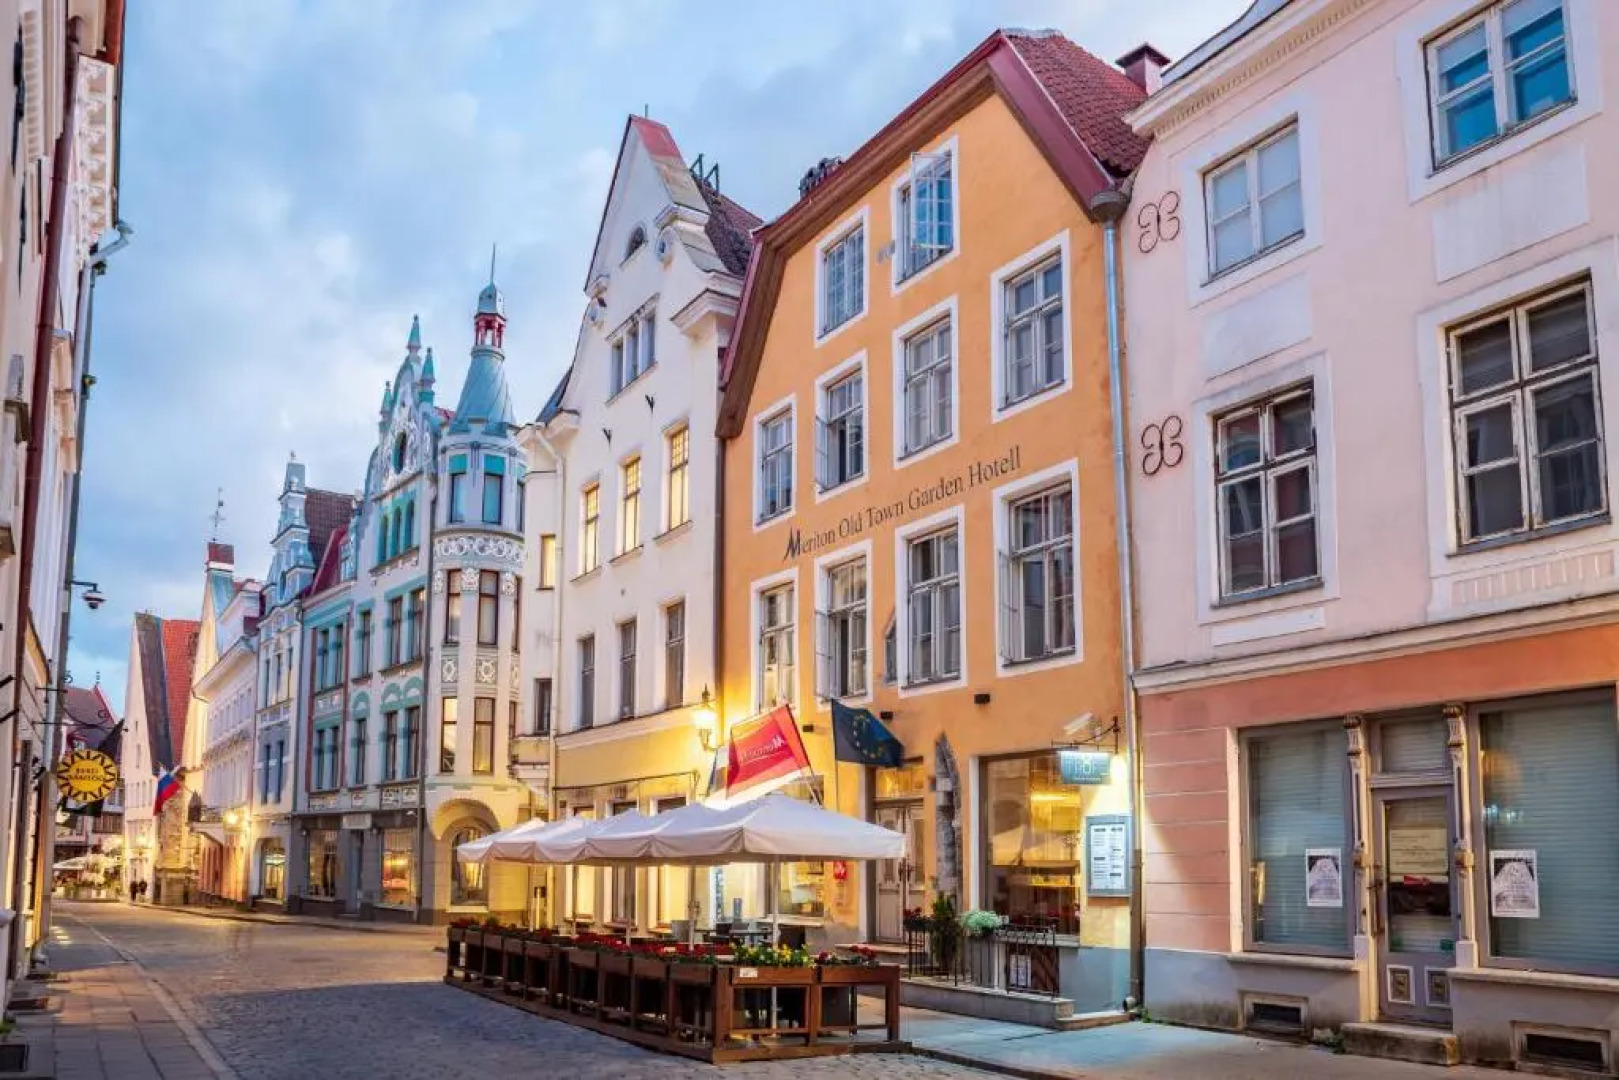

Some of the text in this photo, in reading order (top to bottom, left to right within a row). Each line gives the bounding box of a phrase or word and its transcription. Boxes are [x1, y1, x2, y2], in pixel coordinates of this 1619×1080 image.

[783, 445, 1020, 562] Meriton Old Town Garden Hotell
